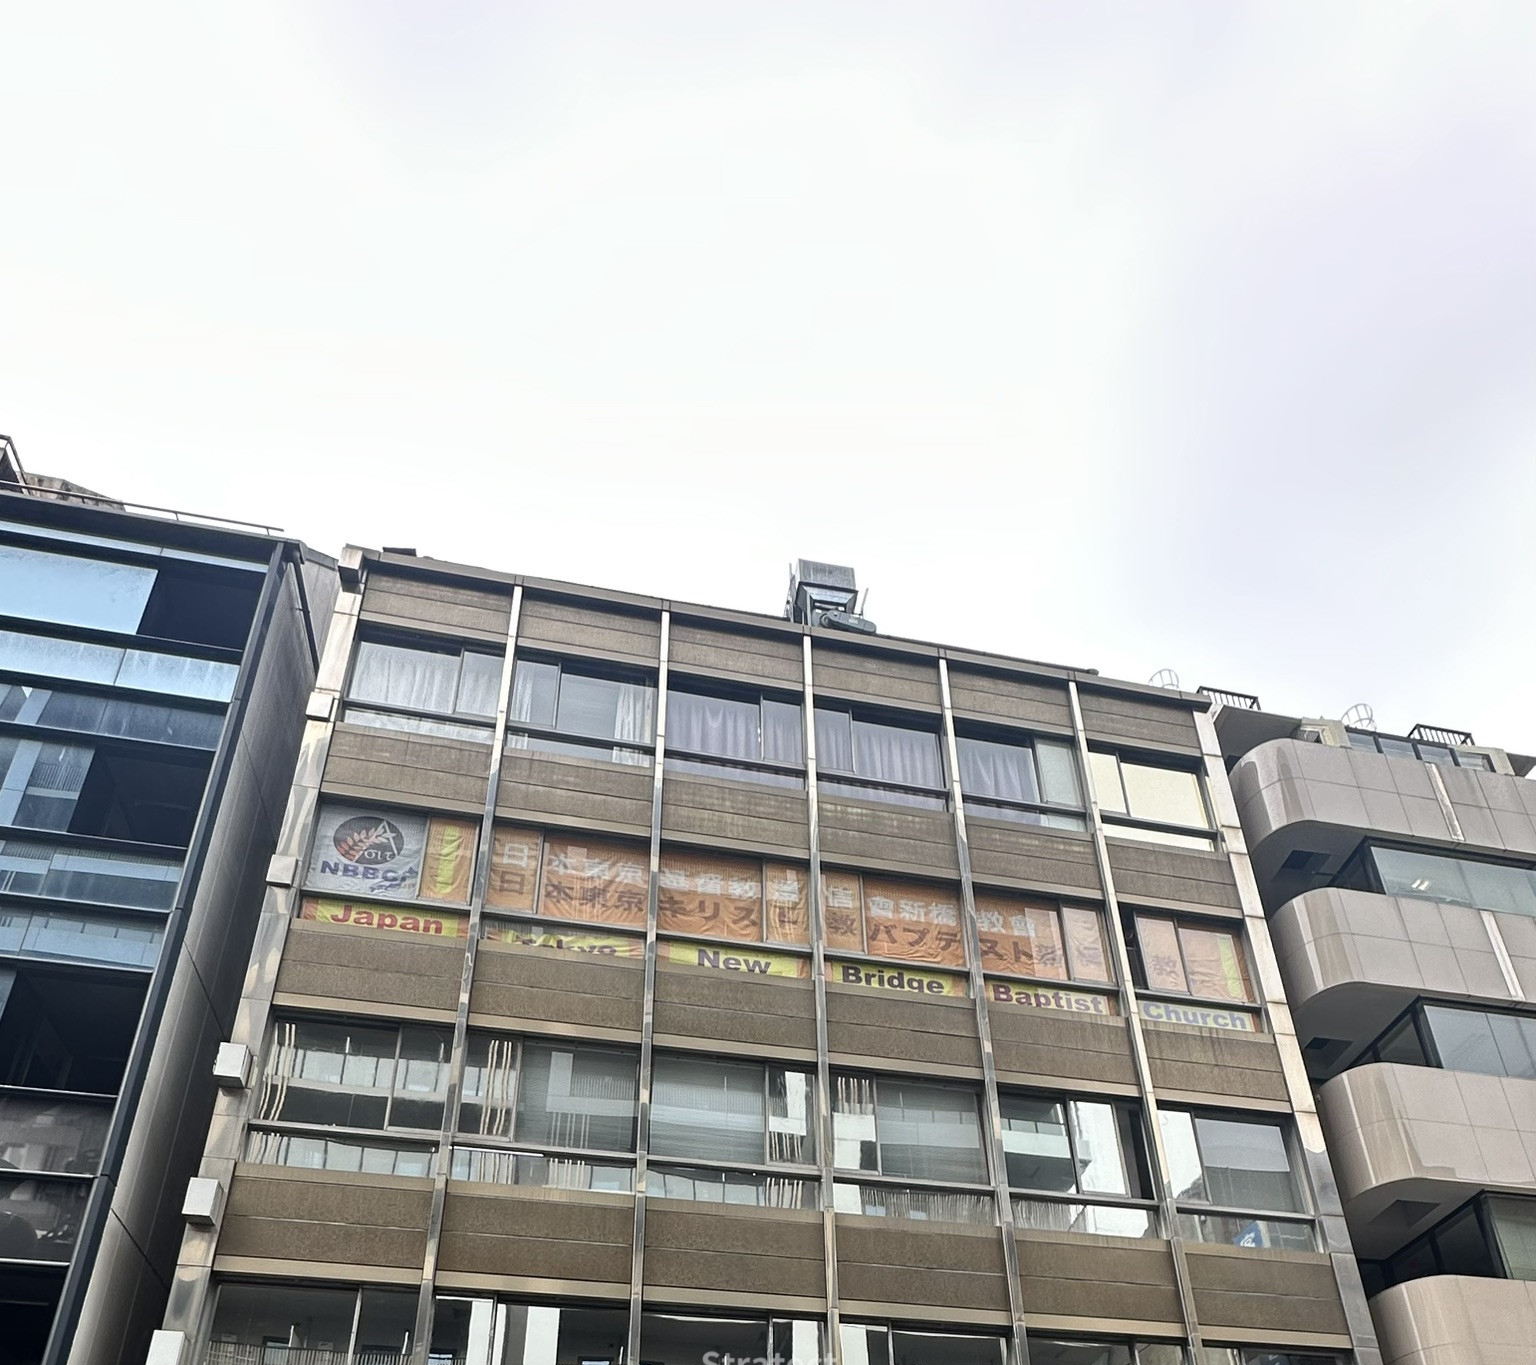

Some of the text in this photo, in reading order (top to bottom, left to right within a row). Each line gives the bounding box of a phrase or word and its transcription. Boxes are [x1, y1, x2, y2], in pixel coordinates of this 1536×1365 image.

[330, 904, 443, 935] Japan
[697, 948, 772, 975] New
[841, 964, 945, 994] Bridge
[992, 983, 1103, 1014] Baptist
[1142, 1002, 1248, 1030] Church
